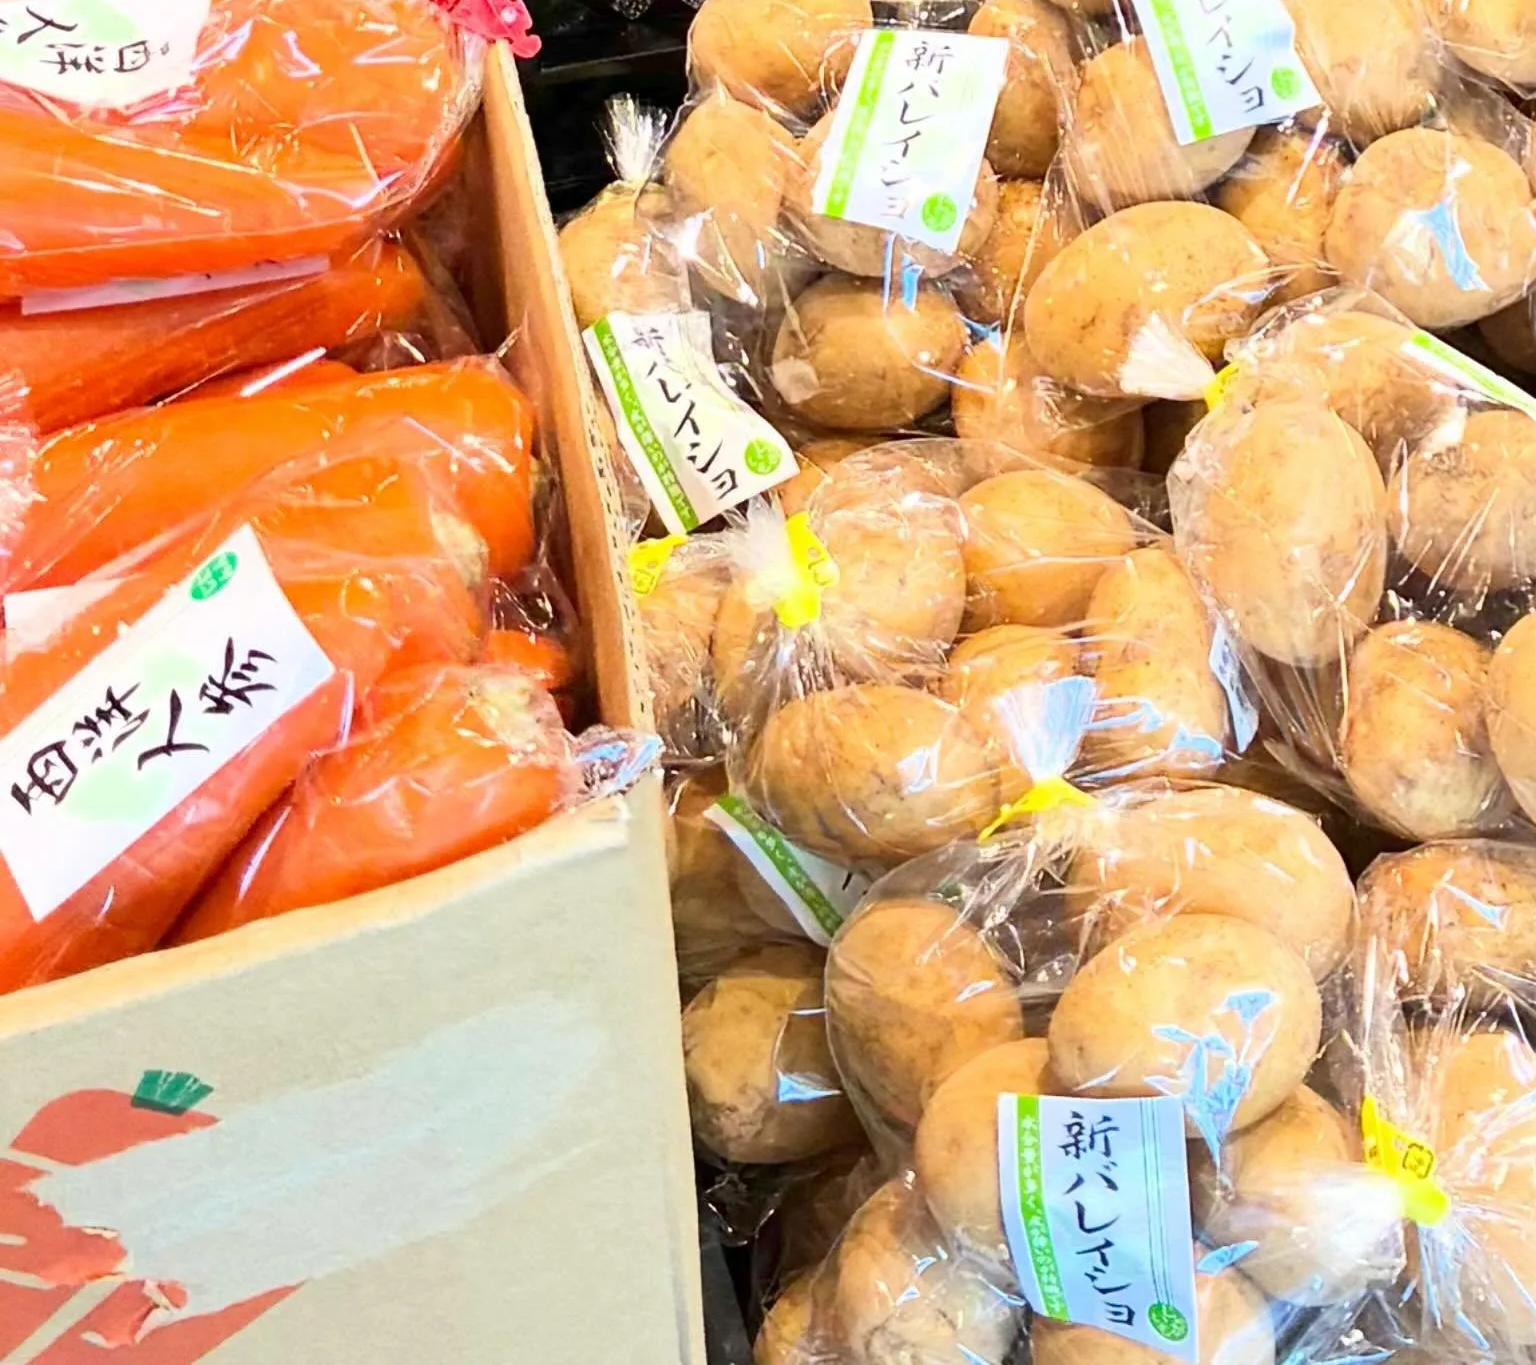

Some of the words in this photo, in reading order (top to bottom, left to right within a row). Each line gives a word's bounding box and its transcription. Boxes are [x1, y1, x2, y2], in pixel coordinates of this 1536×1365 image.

[10, 636, 279, 815] 西洋人参
[1056, 1109, 1138, 1328] 新バレイショ
